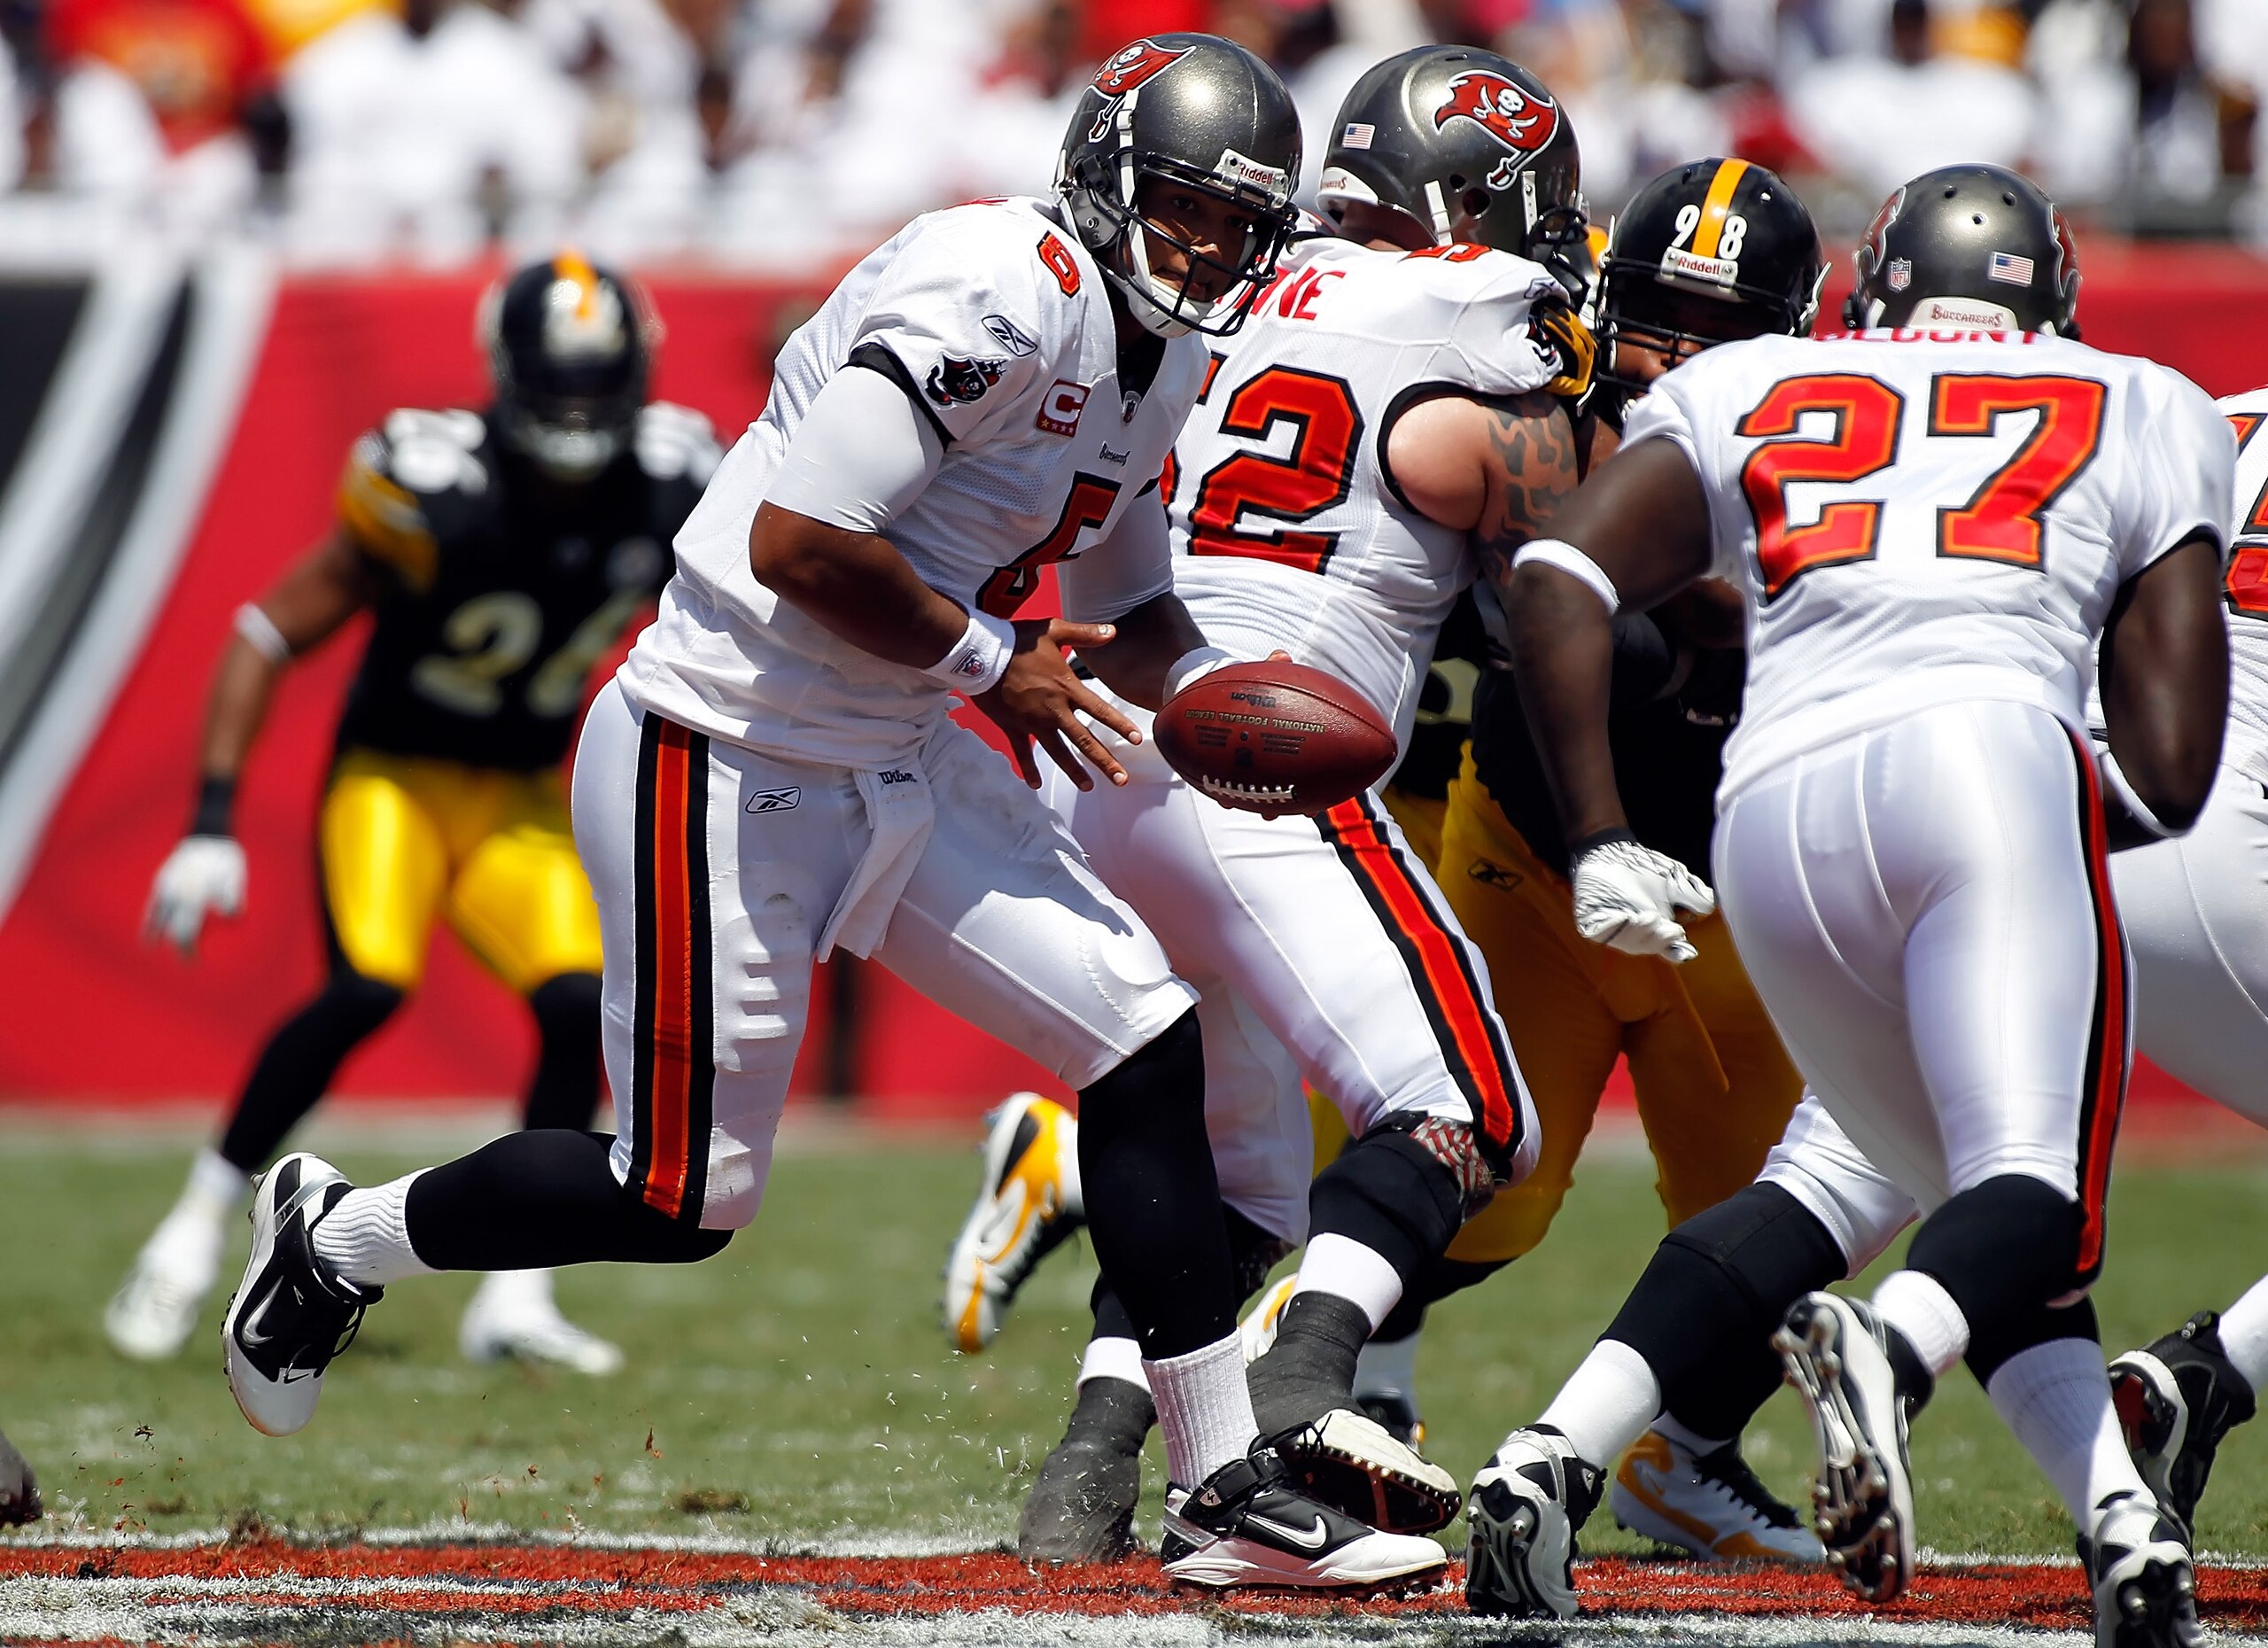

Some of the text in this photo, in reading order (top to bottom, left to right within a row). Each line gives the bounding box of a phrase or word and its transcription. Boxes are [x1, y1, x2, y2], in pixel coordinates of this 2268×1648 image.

[1239, 162, 1275, 185] Riddell
[1671, 204, 1748, 260] 98
[1677, 257, 1720, 275] Riddell
[1044, 384, 1086, 424] C
[1159, 350, 1364, 575] 2
[1734, 370, 2109, 606] 27
[1231, 693, 1276, 708] Wilson
[1185, 710, 1324, 733] NATIONAL FOOTBALL LEAGUE
[878, 770, 917, 784] Wilson
